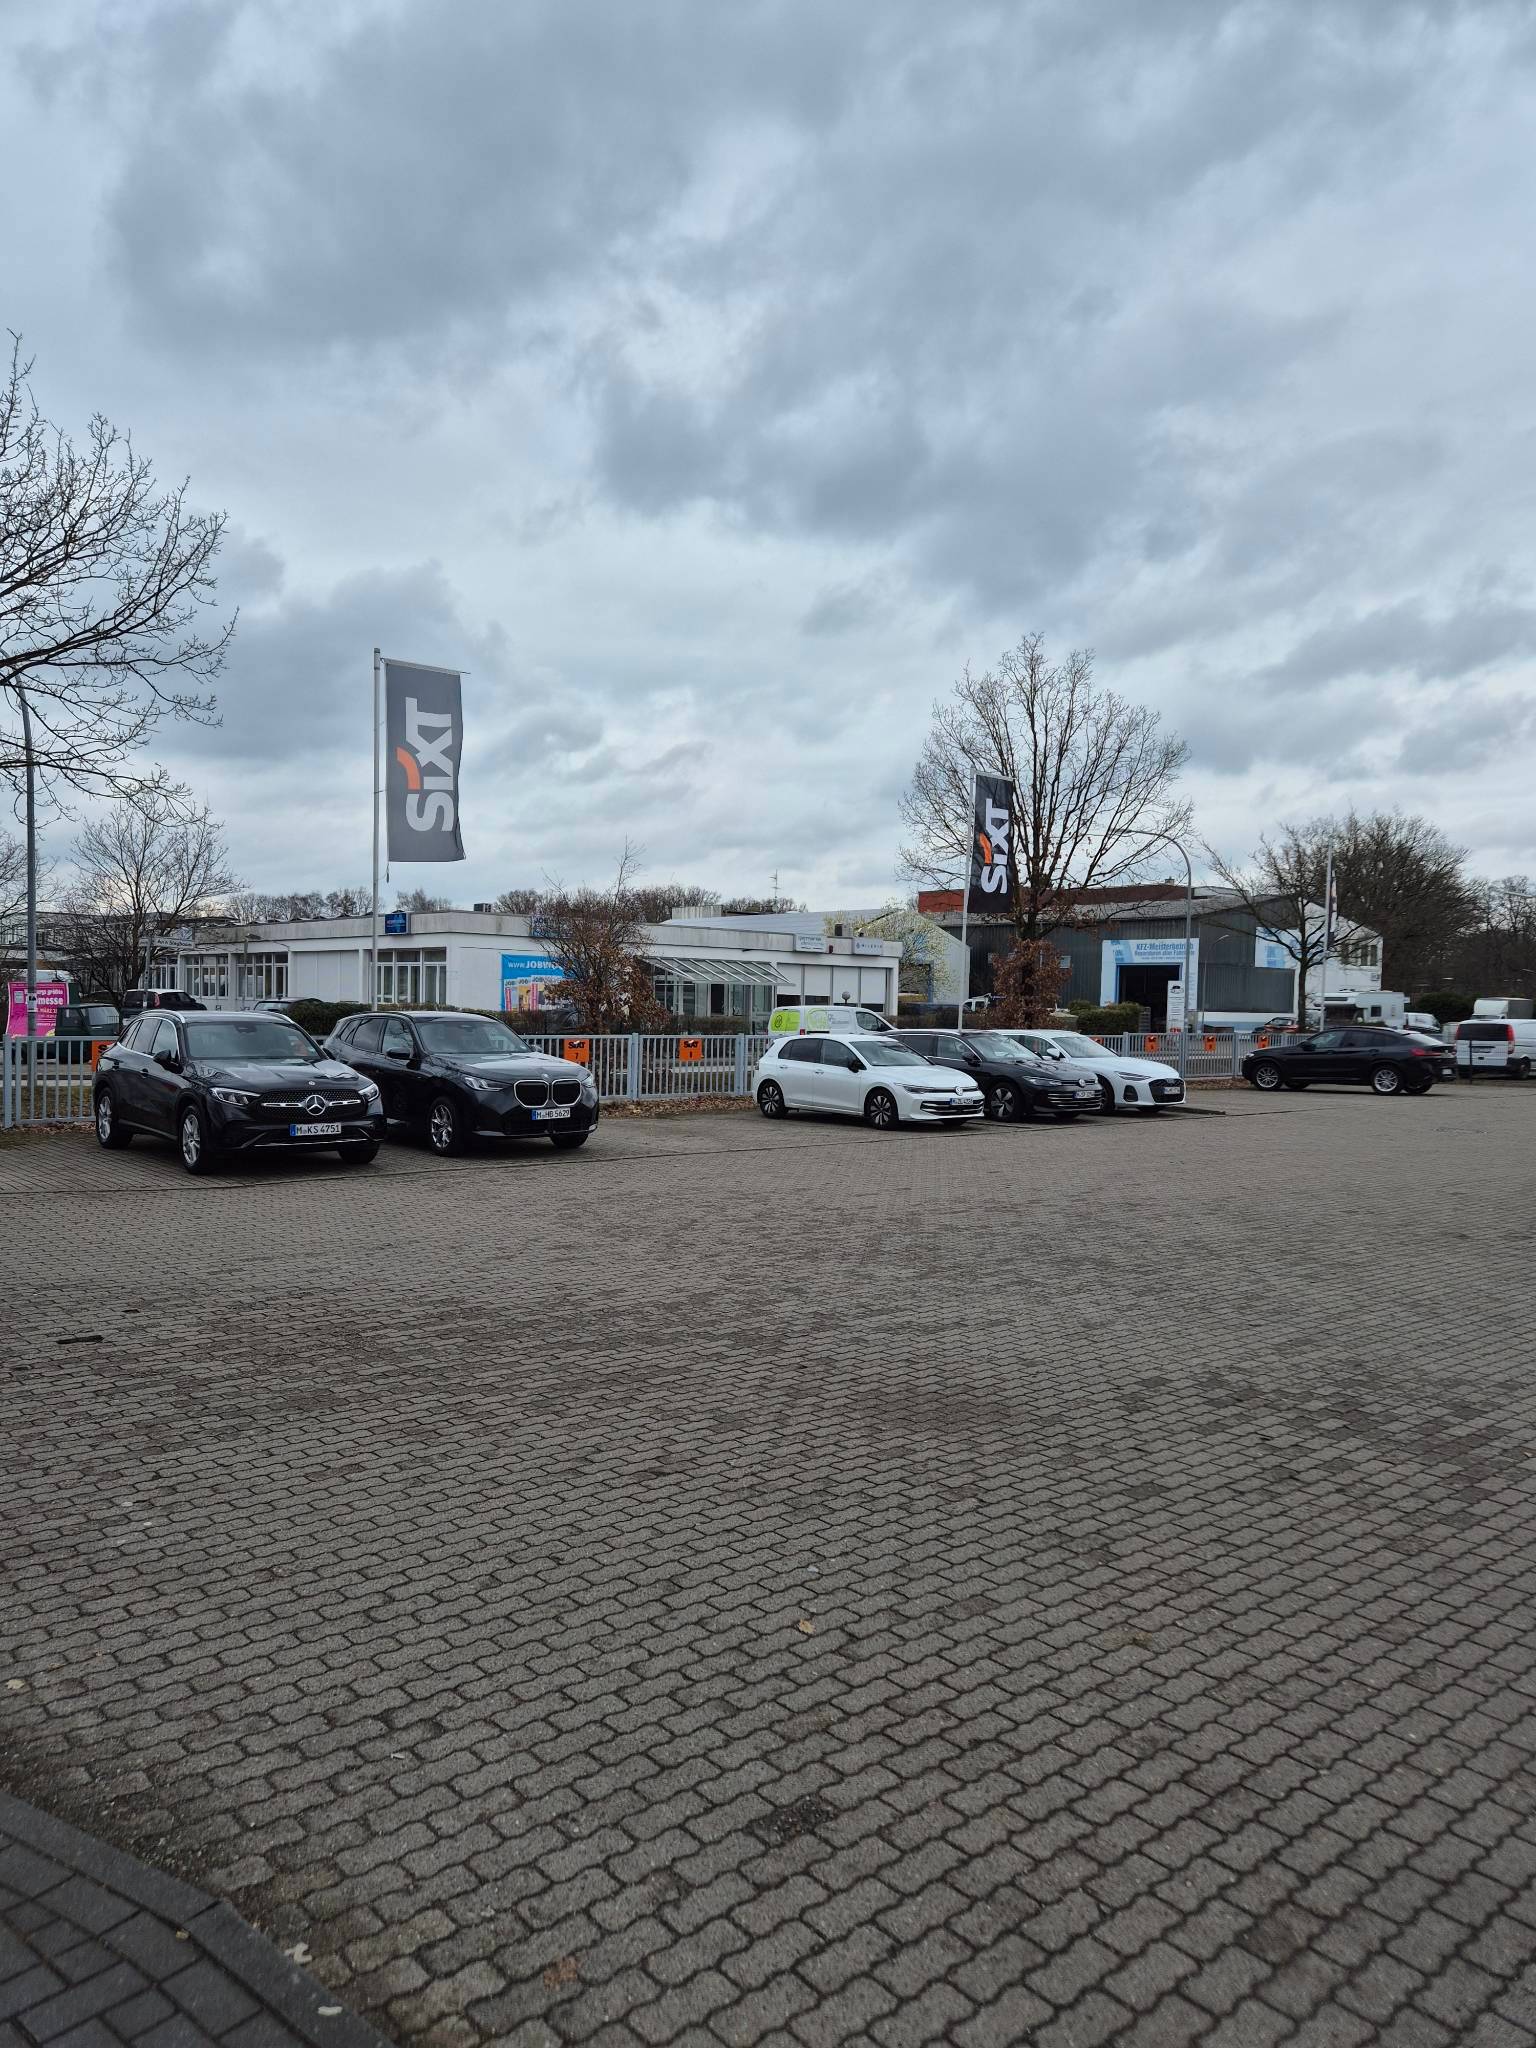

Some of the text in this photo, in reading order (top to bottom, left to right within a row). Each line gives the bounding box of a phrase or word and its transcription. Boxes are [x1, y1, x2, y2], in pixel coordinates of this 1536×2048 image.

[397, 697, 455, 832] SIXT
[979, 798, 1009, 894] SIXT
[307, 1126, 319, 1134] KS
[320, 1125, 339, 1133] 4751
